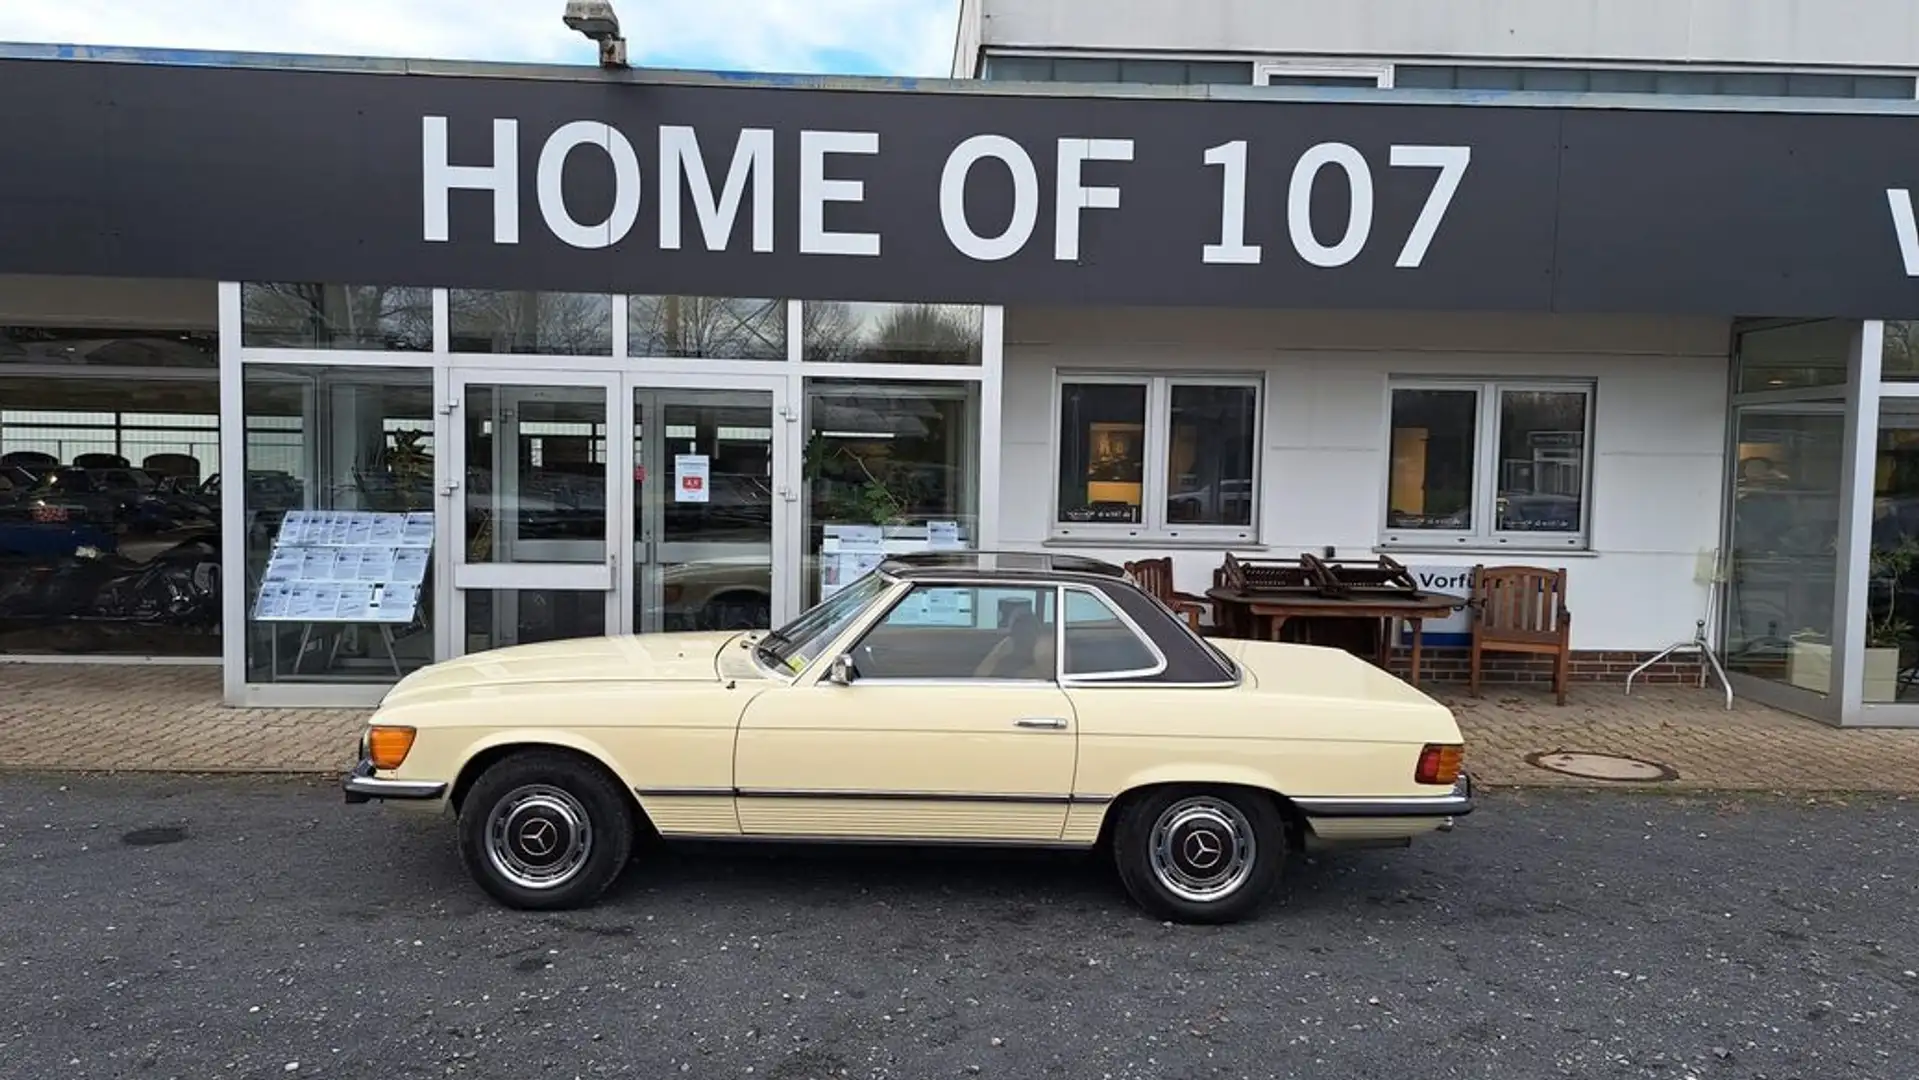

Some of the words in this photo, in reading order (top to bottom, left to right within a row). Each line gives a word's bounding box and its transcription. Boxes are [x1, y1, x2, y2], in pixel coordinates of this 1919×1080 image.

[423, 116, 881, 256] HOME
[939, 134, 1134, 260] OF
[1203, 140, 1471, 267] 107
